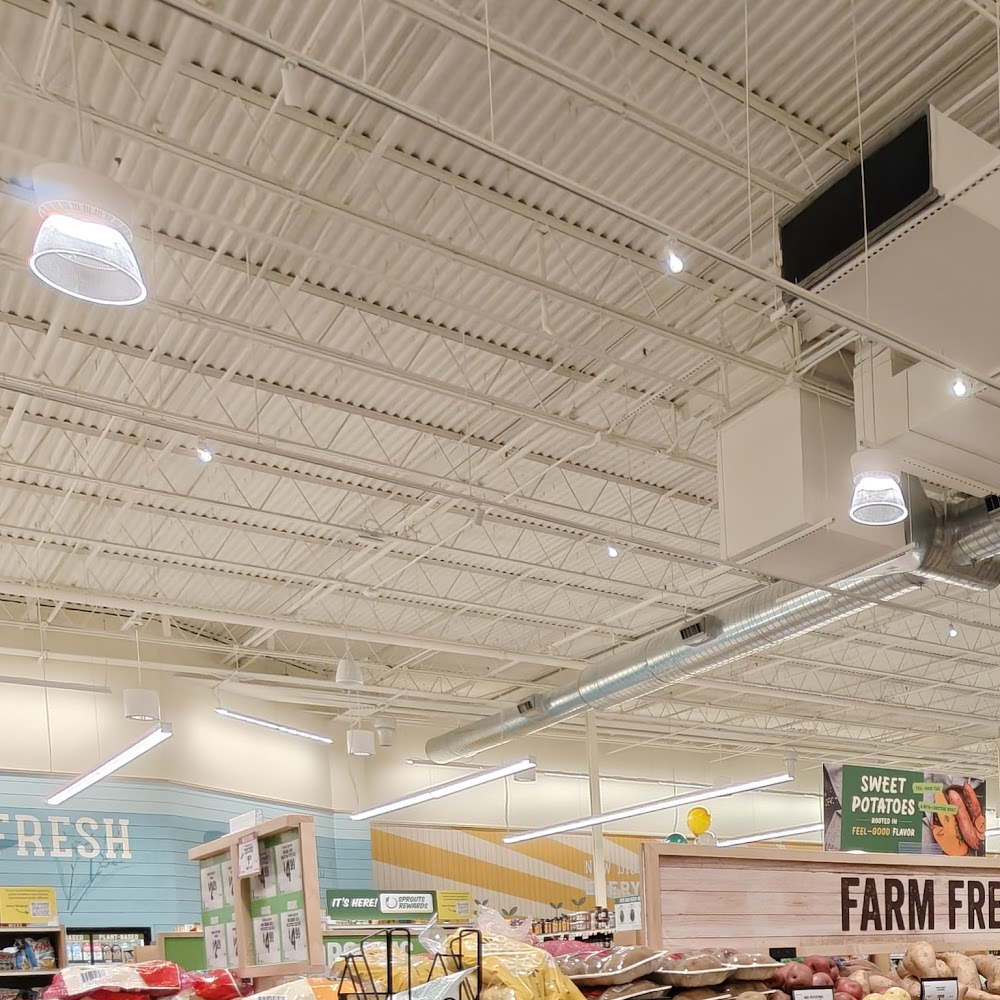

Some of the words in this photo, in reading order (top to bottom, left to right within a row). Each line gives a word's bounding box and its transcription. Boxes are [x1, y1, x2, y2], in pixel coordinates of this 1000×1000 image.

[860, 775, 907, 794] SWEET
[851, 796, 916, 816] POTATOES
[871, 817, 890, 825] ROOTED
[891, 818, 898, 826] IN
[851, 826, 891, 836] FEEL-GOOD
[892, 827, 916, 837] FLAVOR
[332, 896, 350, 908] IT'S
[351, 896, 379, 908] HERE!
[399, 902, 429, 910] REWARDS
[840, 877, 935, 932] FARM
